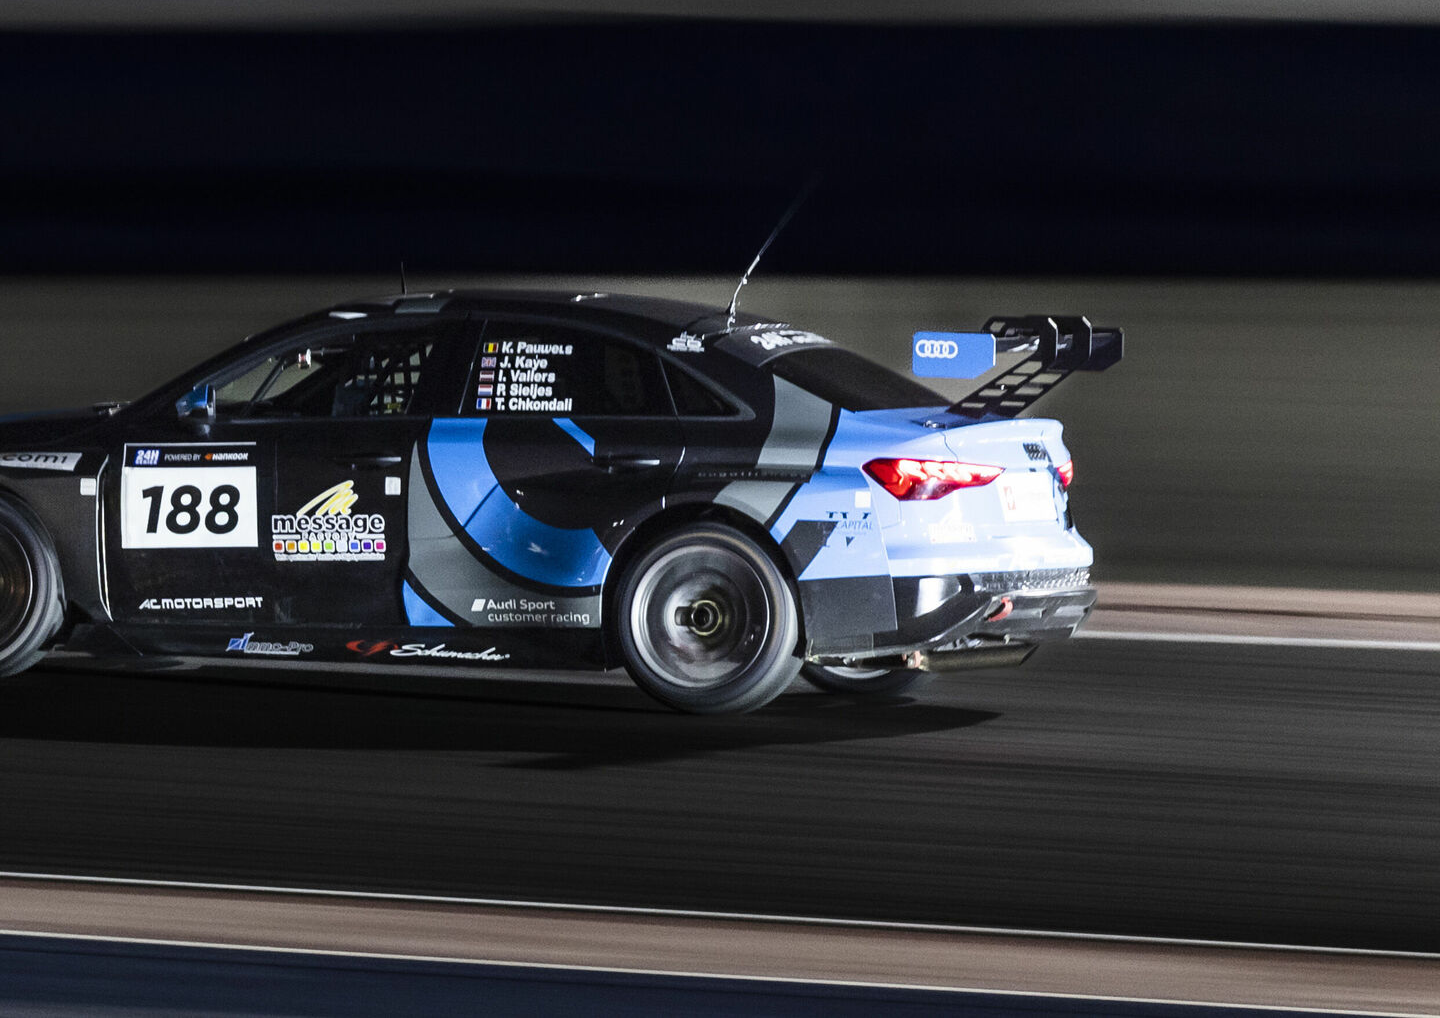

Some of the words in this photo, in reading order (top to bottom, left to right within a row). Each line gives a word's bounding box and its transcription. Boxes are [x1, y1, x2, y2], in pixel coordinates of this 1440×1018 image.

[501, 341, 514, 354] K.
[499, 356, 511, 369] J.
[515, 356, 548, 371] Kaye
[495, 398, 505, 411] T.
[164, 453, 192, 461] POWERED
[192, 453, 201, 461] BY
[142, 484, 240, 535] 188
[272, 513, 385, 534] message
[161, 597, 263, 609] MOTORSPORT
[487, 599, 516, 610] Audi
[520, 599, 555, 612] Sport
[487, 613, 548, 623] customer
[551, 612, 590, 625] racing
